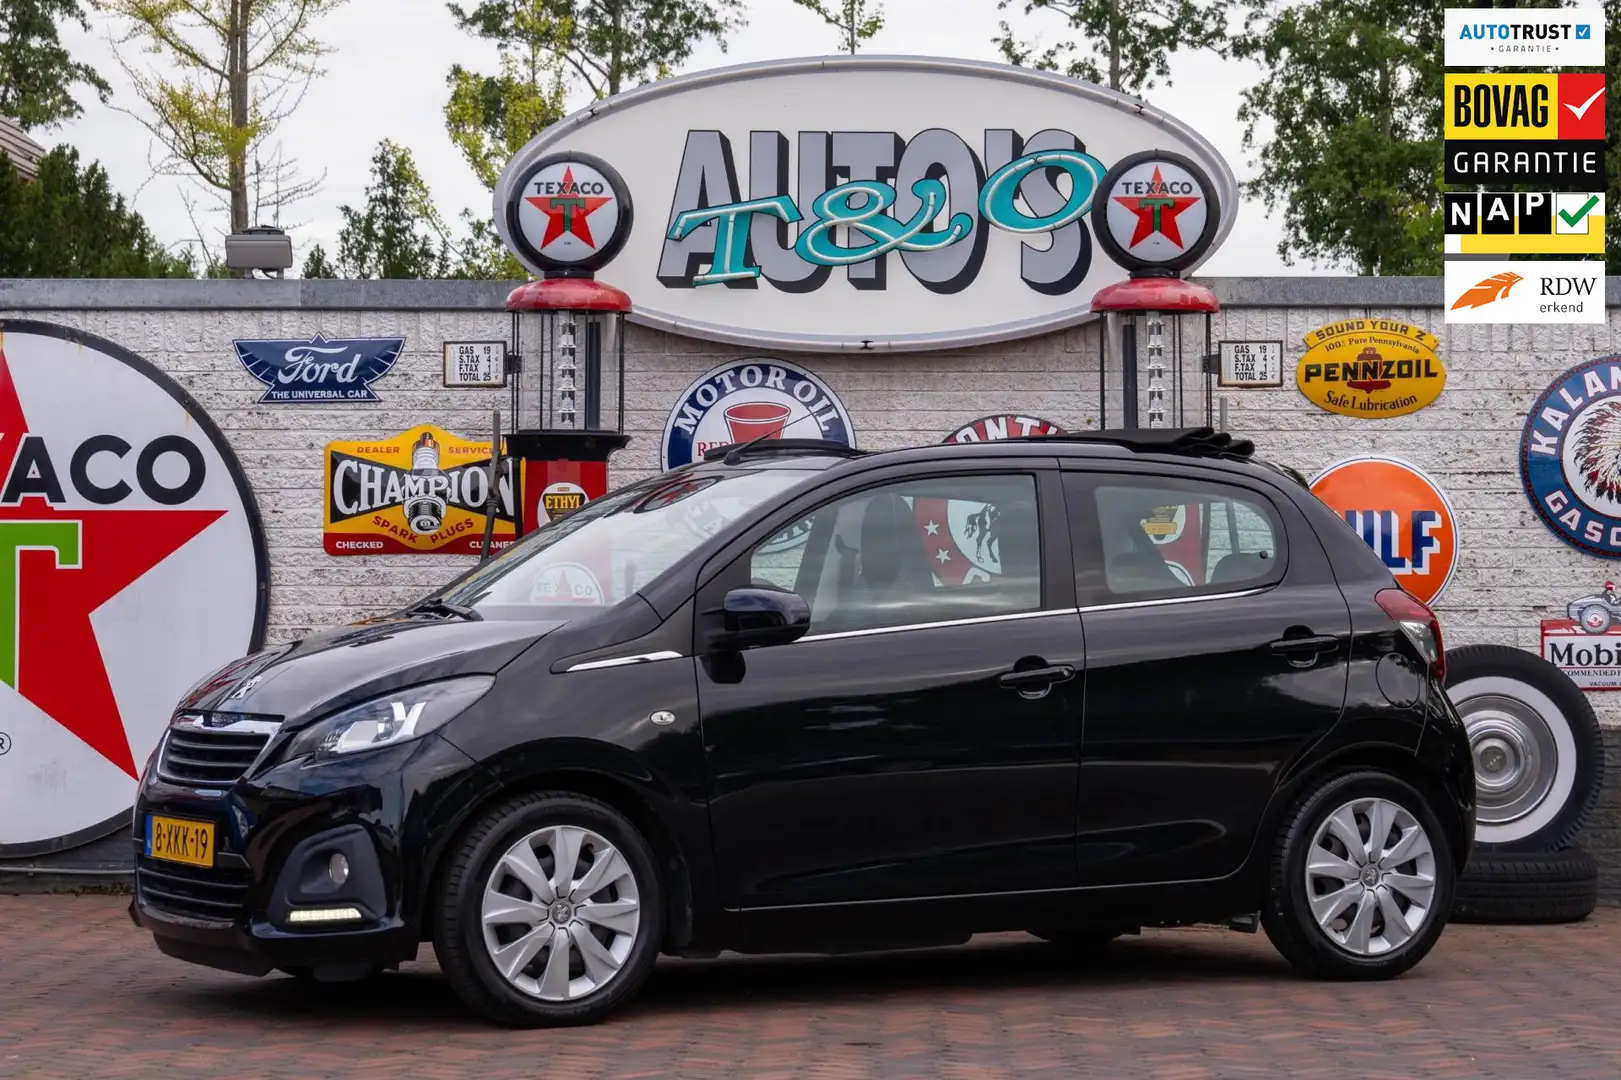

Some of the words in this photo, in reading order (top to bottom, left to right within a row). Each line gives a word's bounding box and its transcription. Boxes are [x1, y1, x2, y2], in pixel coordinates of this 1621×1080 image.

[534, 182, 604, 195] TEXACO
[1122, 181, 1192, 194] TEXACO
[656, 128, 1092, 295] AUTO'S
[667, 194, 805, 287] T
[795, 178, 973, 266] &
[978, 149, 1108, 234] O
[1316, 320, 1365, 340] SOUND
[1370, 320, 1409, 334] YOUR
[1415, 331, 1427, 341] Z
[459, 346, 474, 354] GAS
[483, 346, 491, 354] 19
[1234, 345, 1250, 353] GAS
[1259, 345, 1267, 353] 19
[1349, 337, 1367, 346] Pure
[1369, 336, 1420, 354] Pennsylvania
[459, 355, 480, 363] S.TAX
[486, 355, 491, 363] 4
[1234, 354, 1256, 362] S.TAX
[1263, 354, 1267, 362] 4
[277, 346, 362, 385] Ford
[459, 364, 479, 372] F.TAX
[1234, 363, 1255, 371] F.TAX
[1304, 359, 1439, 383] PENNZOIL
[459, 373, 481, 381] TOTAL
[483, 373, 491, 381] 25
[1234, 372, 1256, 380] TOTAL
[1259, 372, 1267, 380] 25
[271, 391, 290, 399] THE
[291, 390, 345, 399] UNIVERSAL
[348, 390, 368, 398] CAR
[674, 365, 787, 435] MOTOR
[793, 380, 839, 431] OIL
[1324, 390, 1350, 409] Safe
[1351, 394, 1418, 411] Lubrication
[357, 446, 400, 454] DEALER
[333, 457, 515, 517] CHAMPION
[372, 515, 418, 544] SPARK
[429, 518, 475, 544] PLUGS
[335, 540, 384, 549] CHECKED
[469, 541, 516, 549] CLANE
[155, 822, 208, 859] 8-XKK-19
